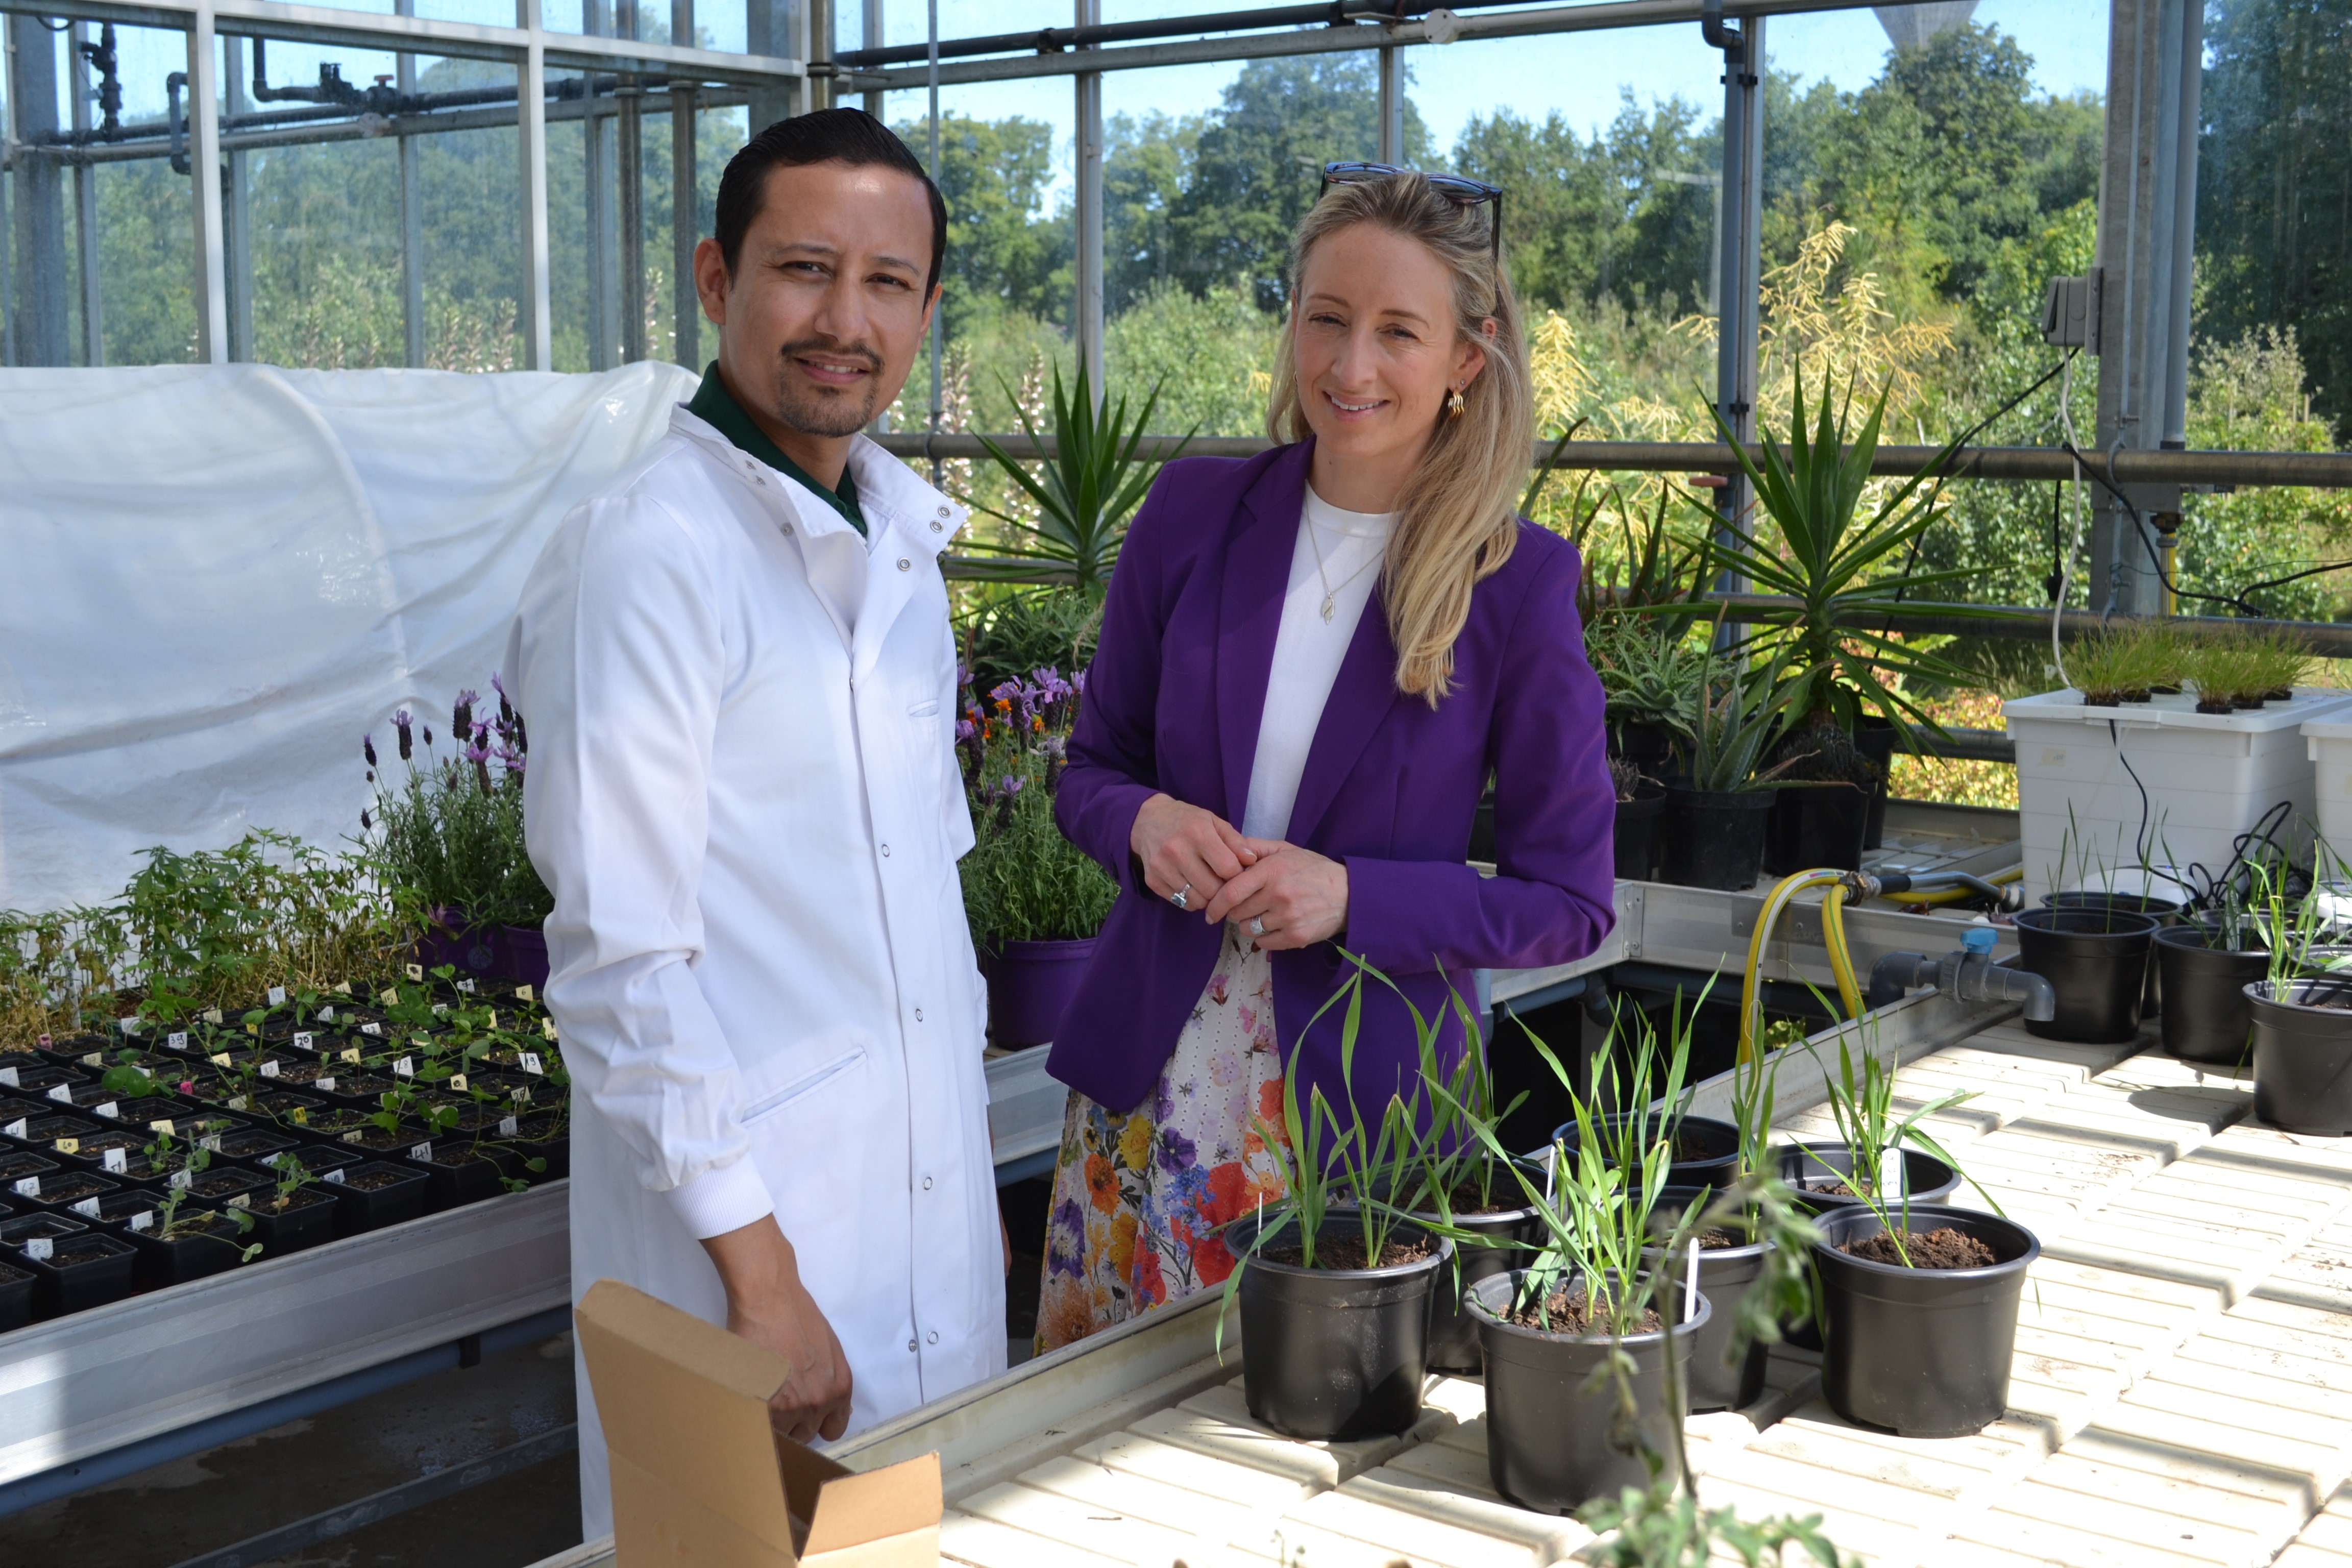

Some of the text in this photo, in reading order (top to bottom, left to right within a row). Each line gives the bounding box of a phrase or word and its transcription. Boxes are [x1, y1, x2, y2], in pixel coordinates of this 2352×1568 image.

[384, 994, 394, 1003] 15
[63, 1141, 72, 1149] 60
[415, 1145, 429, 1159] 41
[22, 1182, 36, 1194] 67
